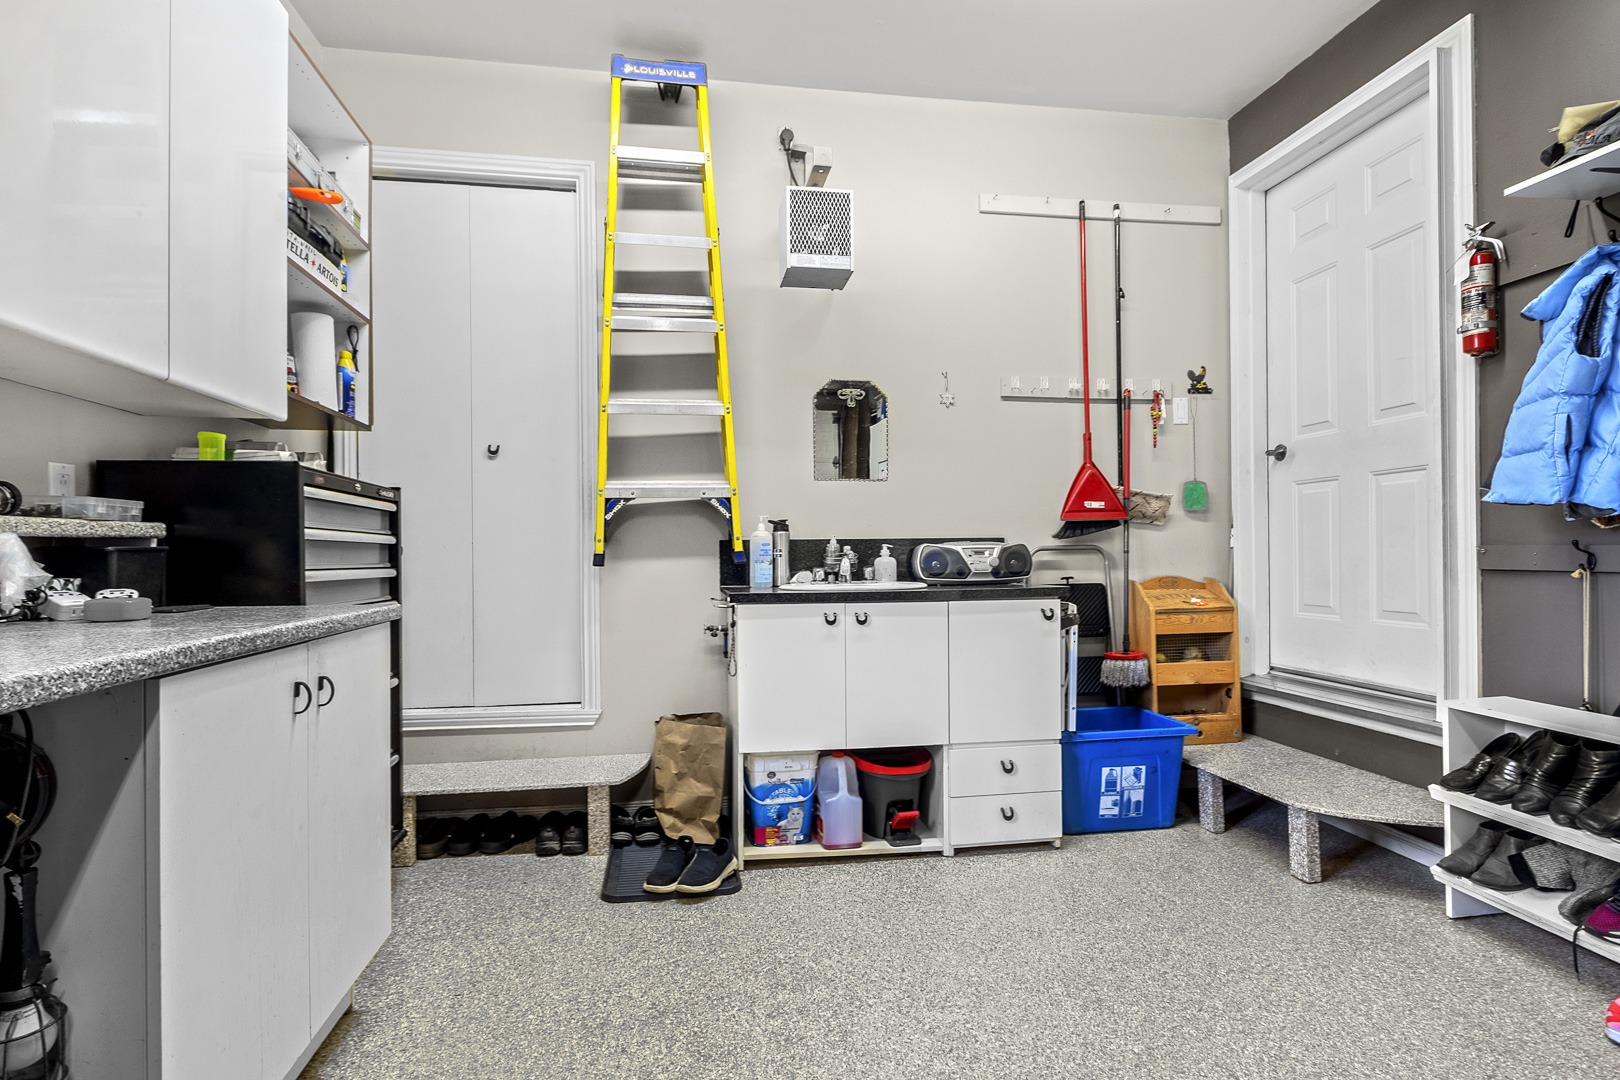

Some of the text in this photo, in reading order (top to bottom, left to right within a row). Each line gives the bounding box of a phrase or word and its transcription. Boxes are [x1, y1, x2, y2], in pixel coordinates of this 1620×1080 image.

[633, 66, 697, 79] LOUISVILLE
[286, 239, 310, 264] TELLA
[316, 263, 339, 287] ARTOIS
[604, 499, 626, 520] SHOX
[710, 498, 732, 518] SHOX
